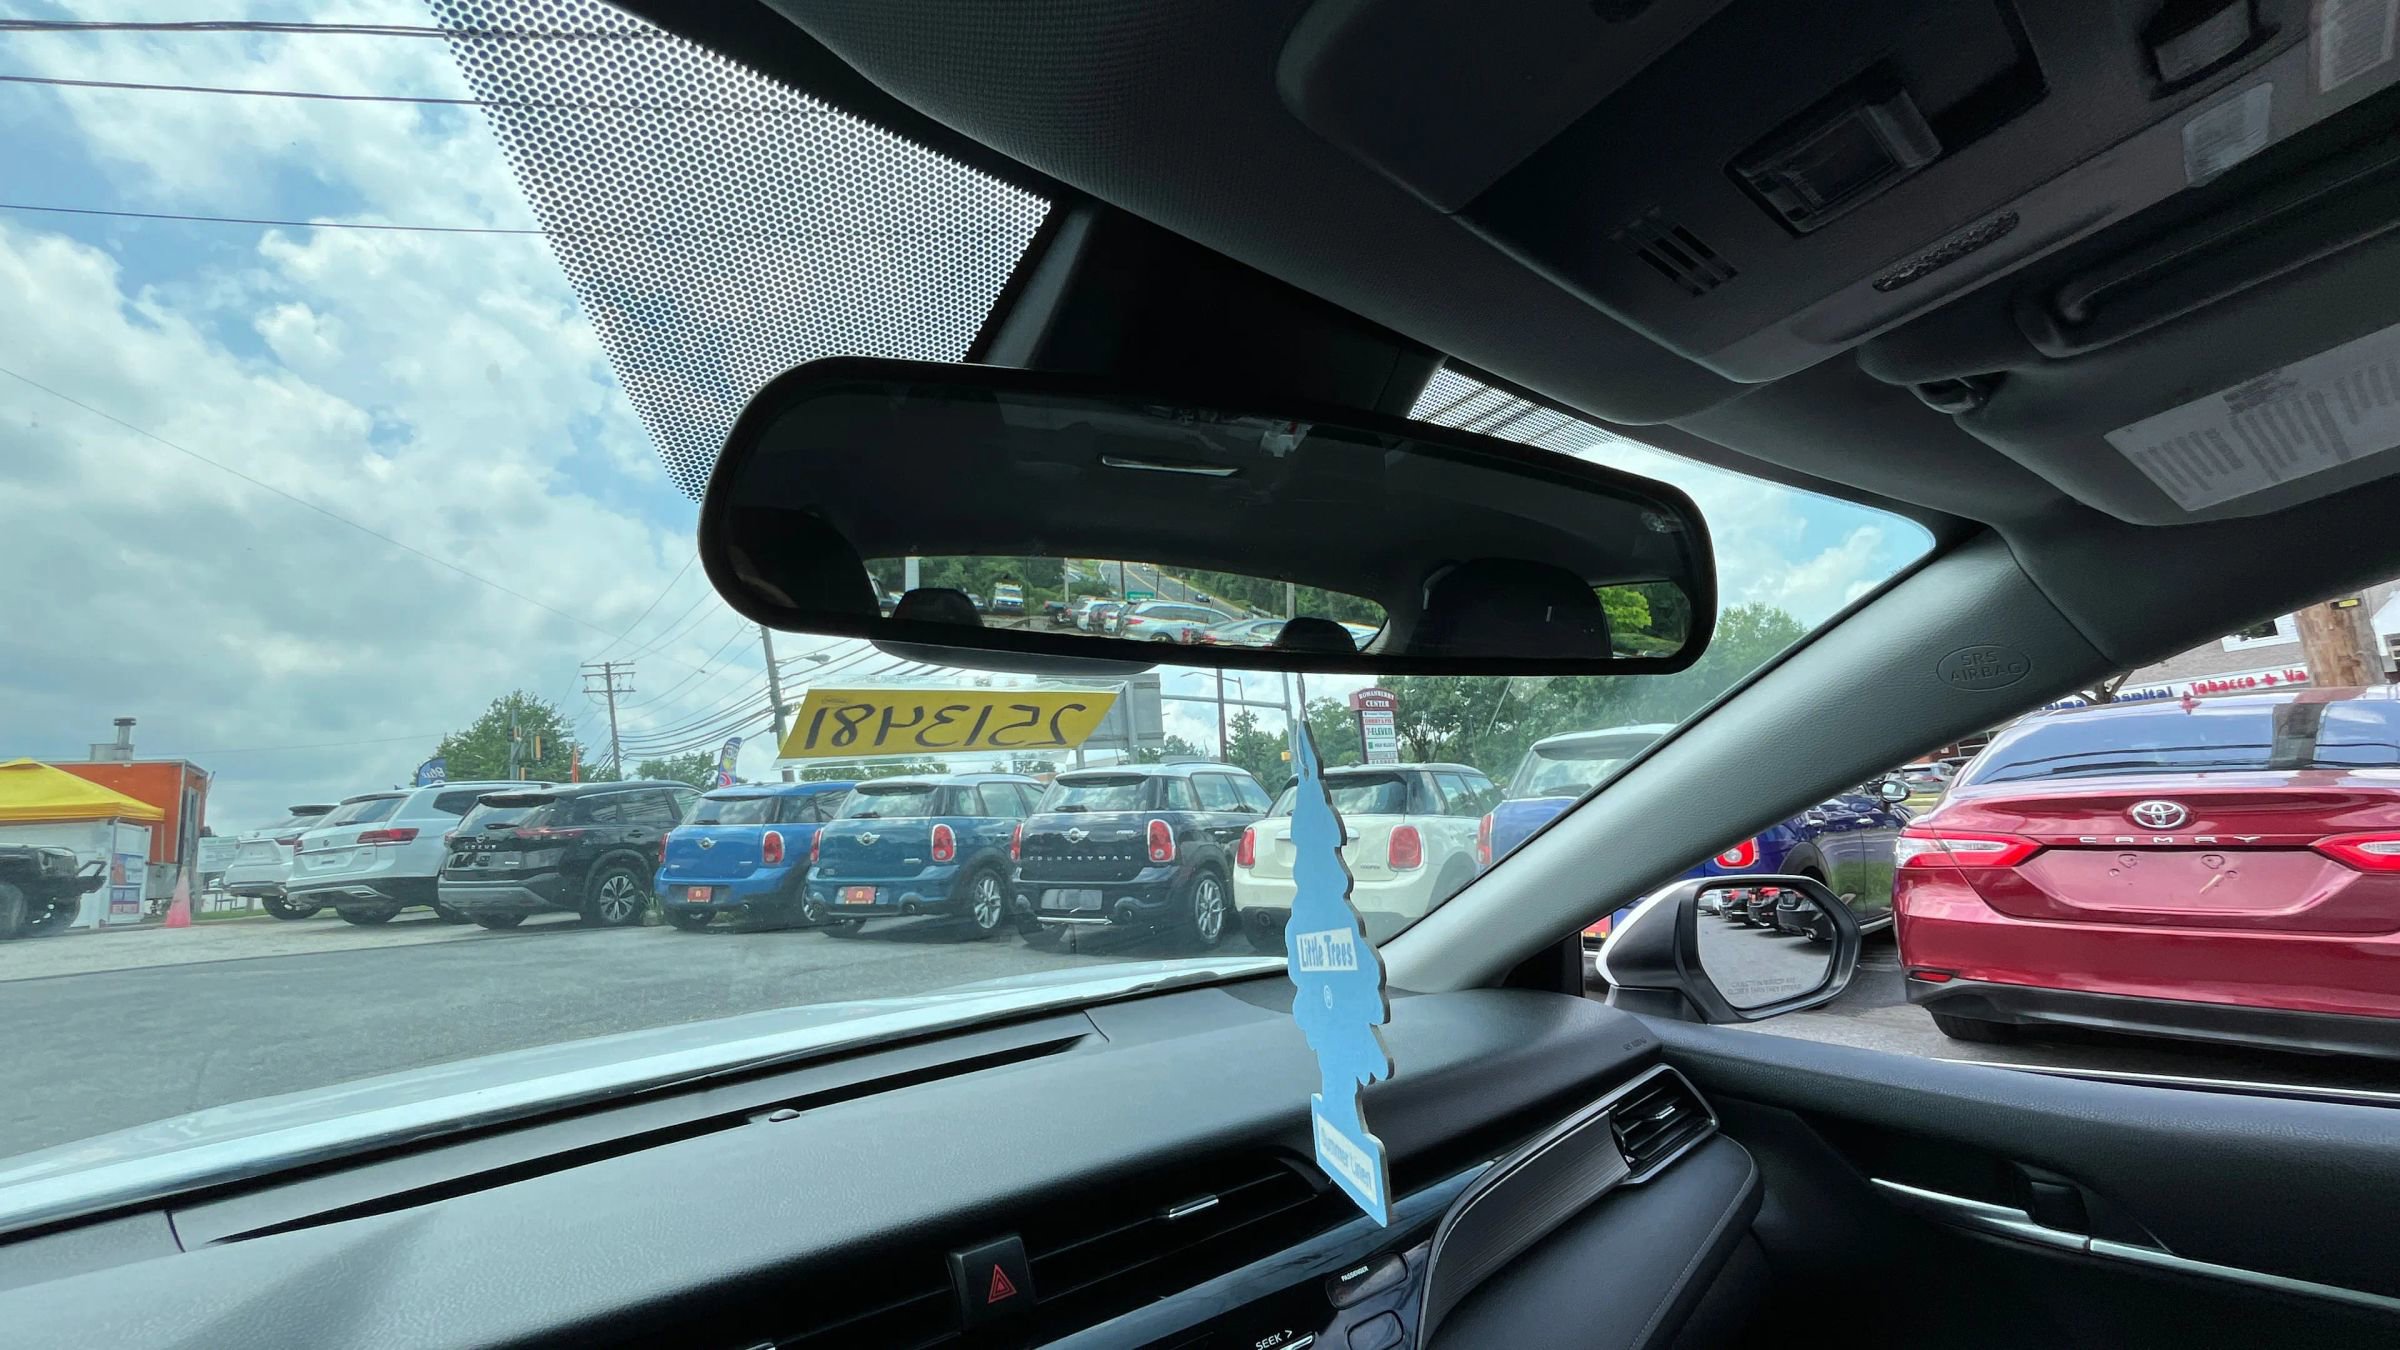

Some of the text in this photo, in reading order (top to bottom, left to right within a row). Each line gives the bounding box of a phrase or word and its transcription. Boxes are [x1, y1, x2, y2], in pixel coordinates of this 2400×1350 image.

[1961, 650, 1998, 666] SRS
[1951, 662, 2022, 681] AIRBAG
[2111, 686, 2174, 703] ospital
[2189, 676, 2256, 696] Tobacco
[1365, 700, 1390, 708] CENTER
[2079, 835, 2262, 844] CAMRY
[1300, 934, 1353, 968] Little Trees
[1255, 1332, 1283, 1350] SEEK
